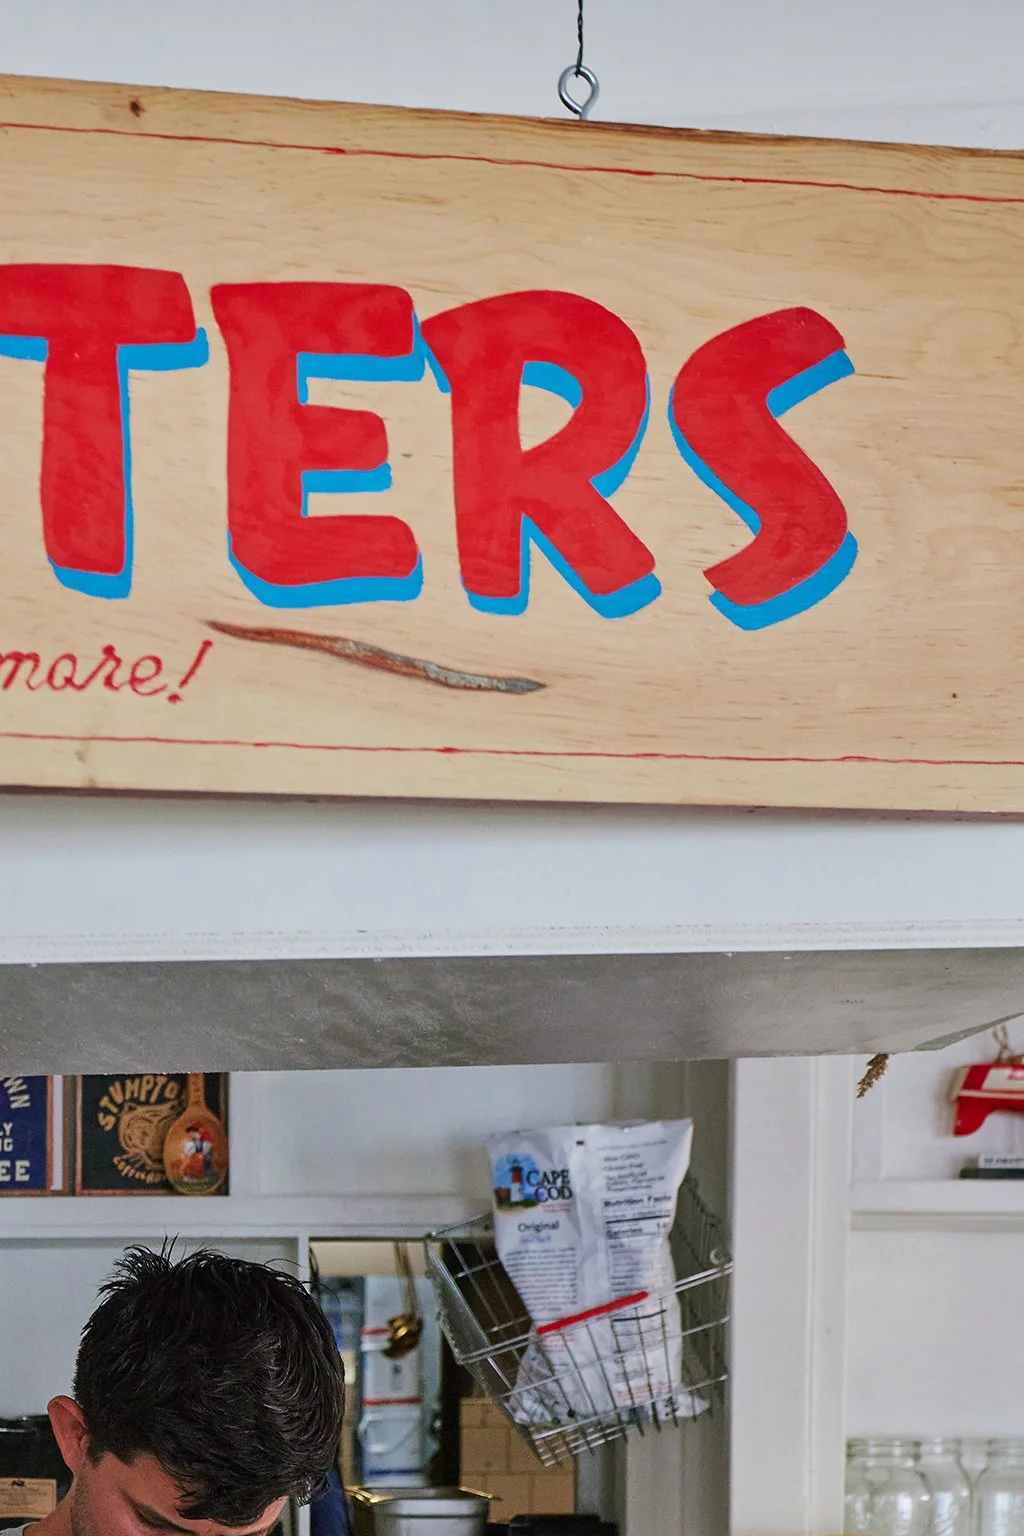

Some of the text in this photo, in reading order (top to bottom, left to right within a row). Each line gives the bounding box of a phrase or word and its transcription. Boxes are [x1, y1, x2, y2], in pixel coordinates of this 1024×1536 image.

[97, 1075, 179, 1131] STUMPTO
[526, 1168, 570, 1187] CAPE
[534, 1185, 573, 1203] COD
[517, 1220, 560, 1233] Original
